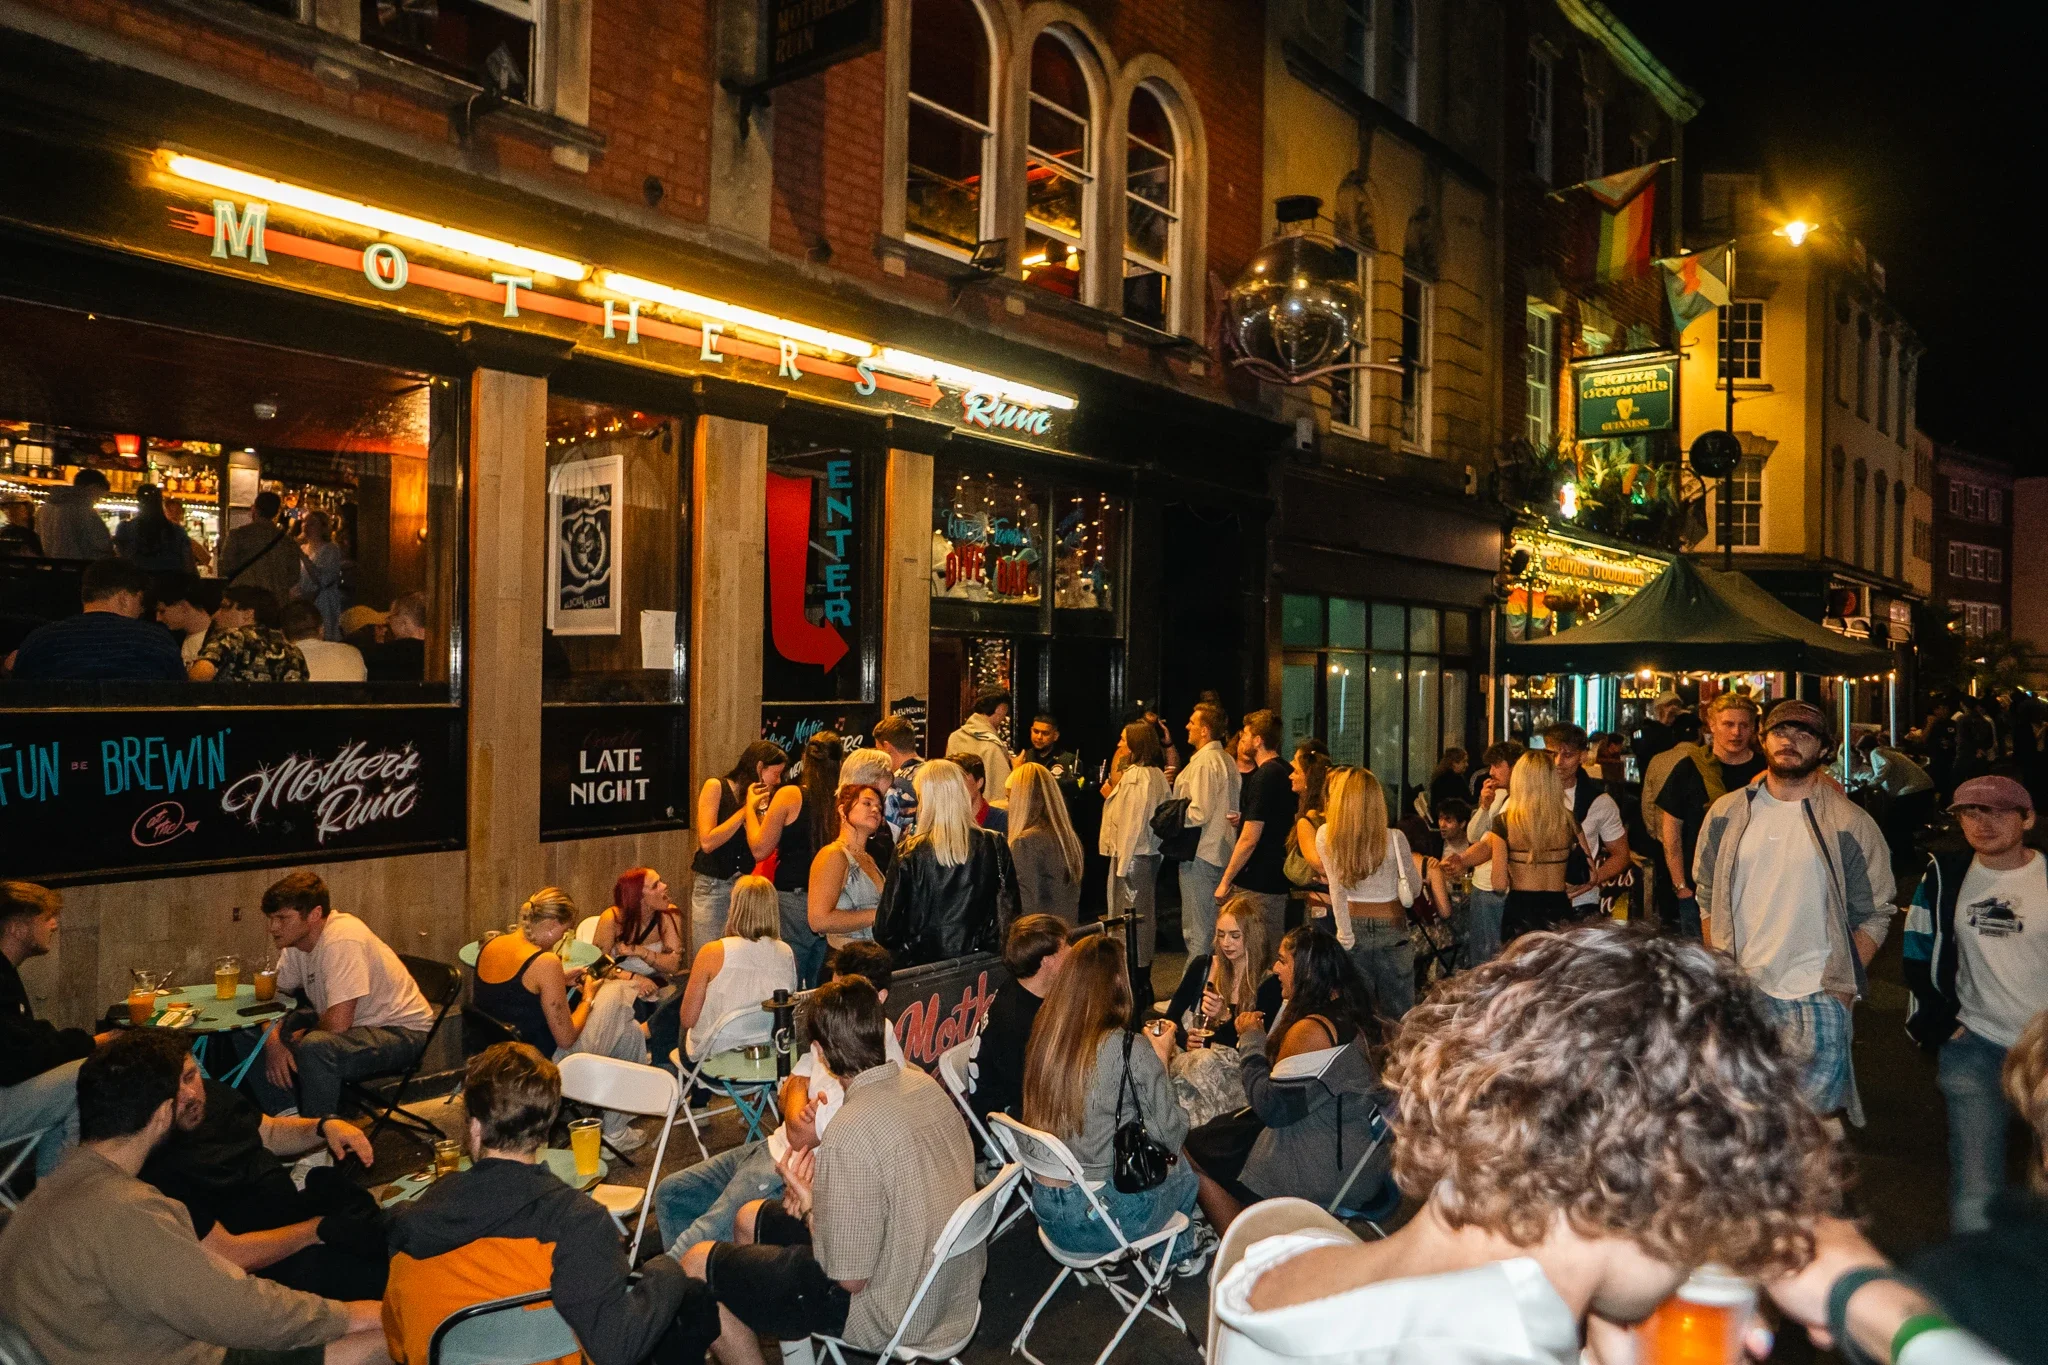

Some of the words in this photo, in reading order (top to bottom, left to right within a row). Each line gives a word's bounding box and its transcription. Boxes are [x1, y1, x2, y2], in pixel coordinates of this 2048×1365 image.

[961, 387, 1054, 436] Ruin
[1601, 418, 1650, 432] GUINNESS
[824, 460, 854, 628] ENTER
[945, 543, 985, 592] DIVE
[995, 556, 1030, 596] BAR
[0, 741, 60, 806] FUN
[71, 761, 89, 771] BE
[221, 740, 420, 824] Mother's
[579, 747, 644, 775] LATE
[316, 780, 418, 844] Ruin
[570, 777, 650, 806] NIGHT
